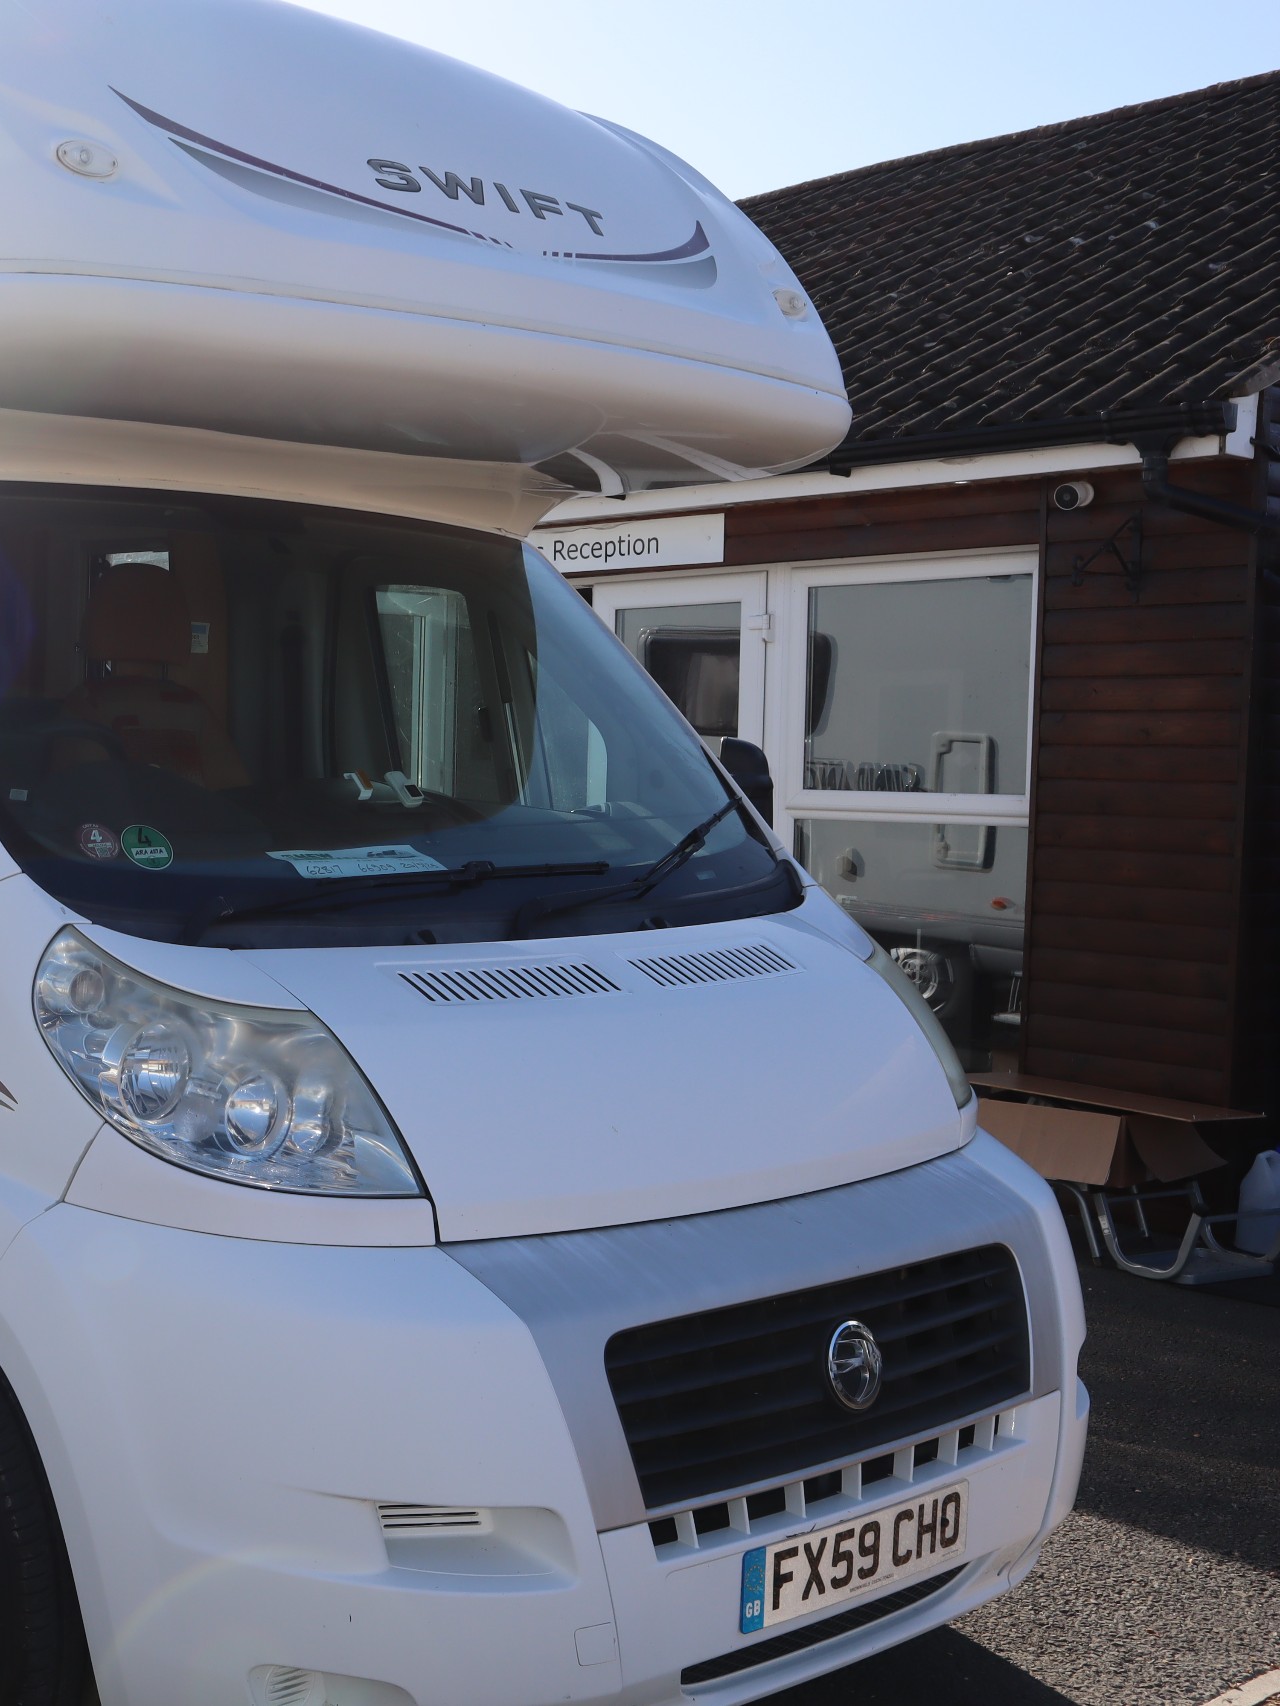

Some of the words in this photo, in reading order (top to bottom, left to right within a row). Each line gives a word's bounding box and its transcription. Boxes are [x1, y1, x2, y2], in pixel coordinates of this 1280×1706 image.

[367, 158, 604, 237] SWIFT
[552, 534, 660, 563] Reception
[90, 829, 103, 842] 4
[138, 827, 152, 847] 4
[772, 1520, 881, 1611] FX59
[892, 1491, 961, 1568] CHO
[745, 1599, 761, 1619] GB
